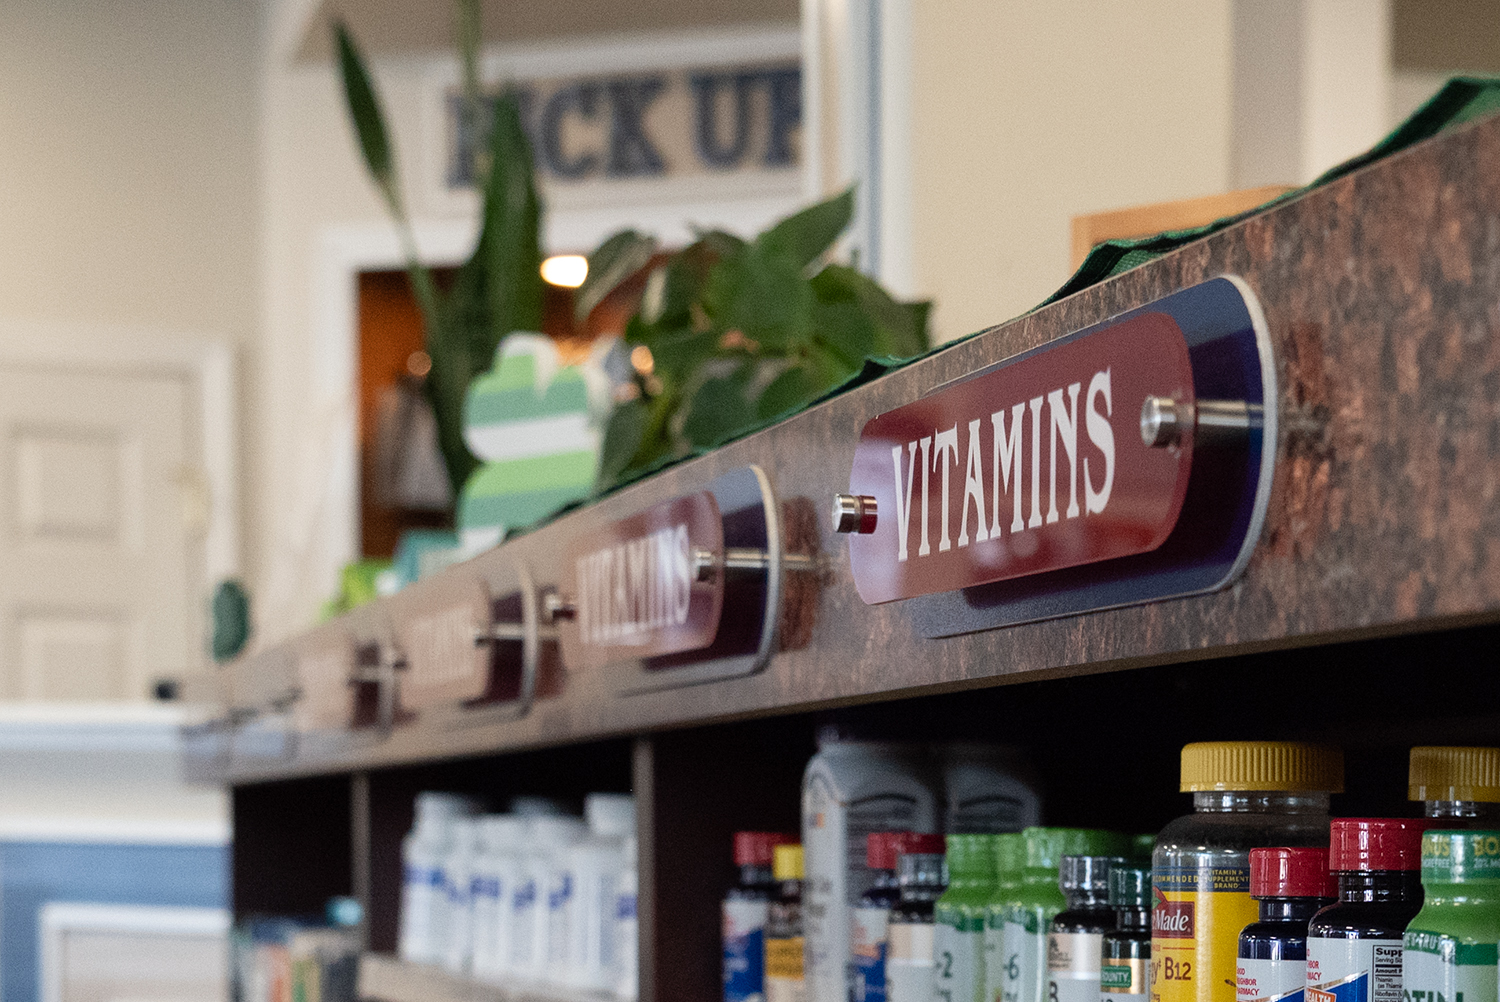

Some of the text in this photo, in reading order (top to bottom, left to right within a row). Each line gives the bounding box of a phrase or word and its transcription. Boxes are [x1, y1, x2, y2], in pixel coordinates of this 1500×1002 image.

[446, 76, 670, 190] PCK
[891, 366, 1117, 562] VITAMINS
[1164, 956, 1192, 981] B12
